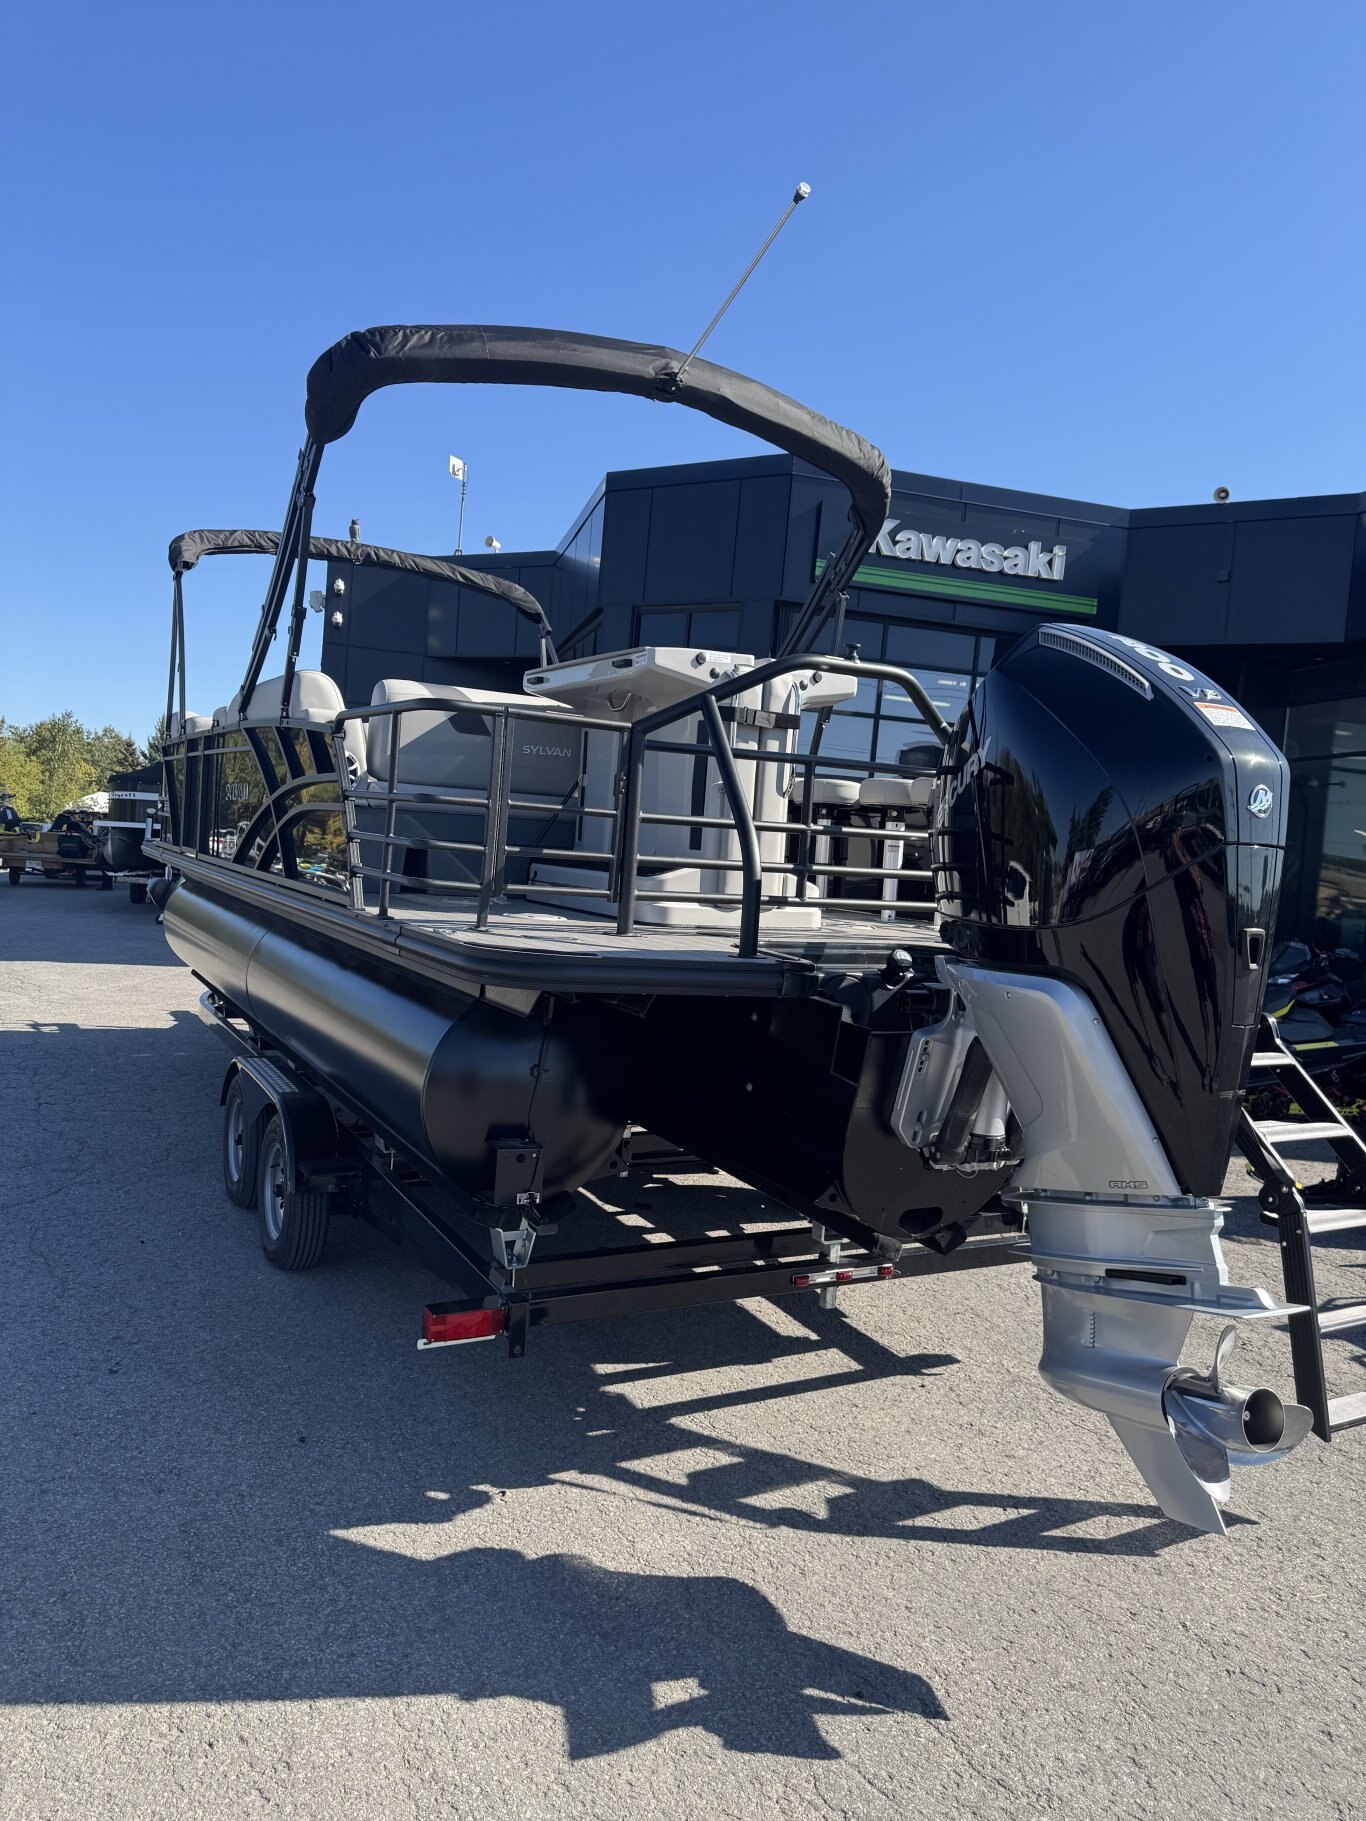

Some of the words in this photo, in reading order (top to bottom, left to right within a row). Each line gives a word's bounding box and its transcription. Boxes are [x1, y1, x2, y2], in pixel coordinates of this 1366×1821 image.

[868, 519, 1067, 581] Kawasaki
[522, 745, 571, 757] SYLVAN
[1109, 1180, 1148, 1189] AMS
